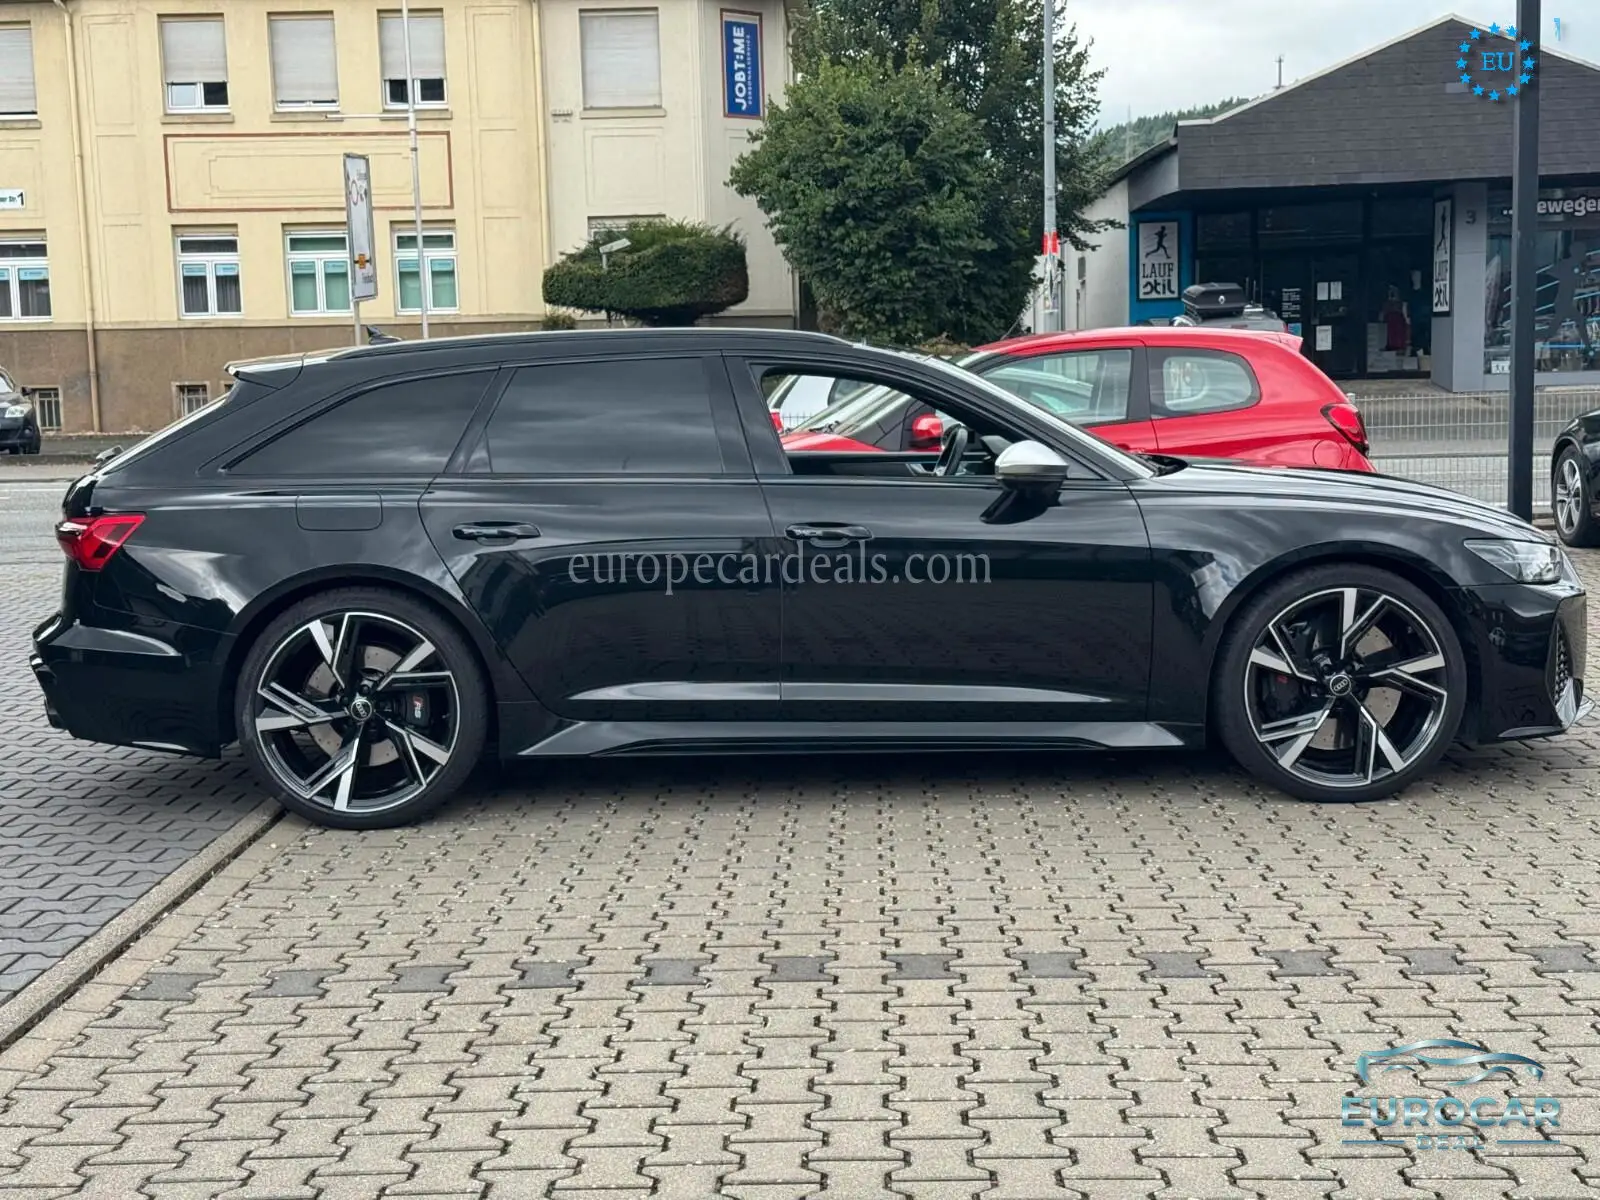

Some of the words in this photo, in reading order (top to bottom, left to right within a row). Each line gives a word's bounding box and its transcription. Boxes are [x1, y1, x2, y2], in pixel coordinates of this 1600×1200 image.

[1537, 197, 1600, 216] ewege
[1465, 209, 1477, 225] 3
[1142, 262, 1174, 278] LAUF
